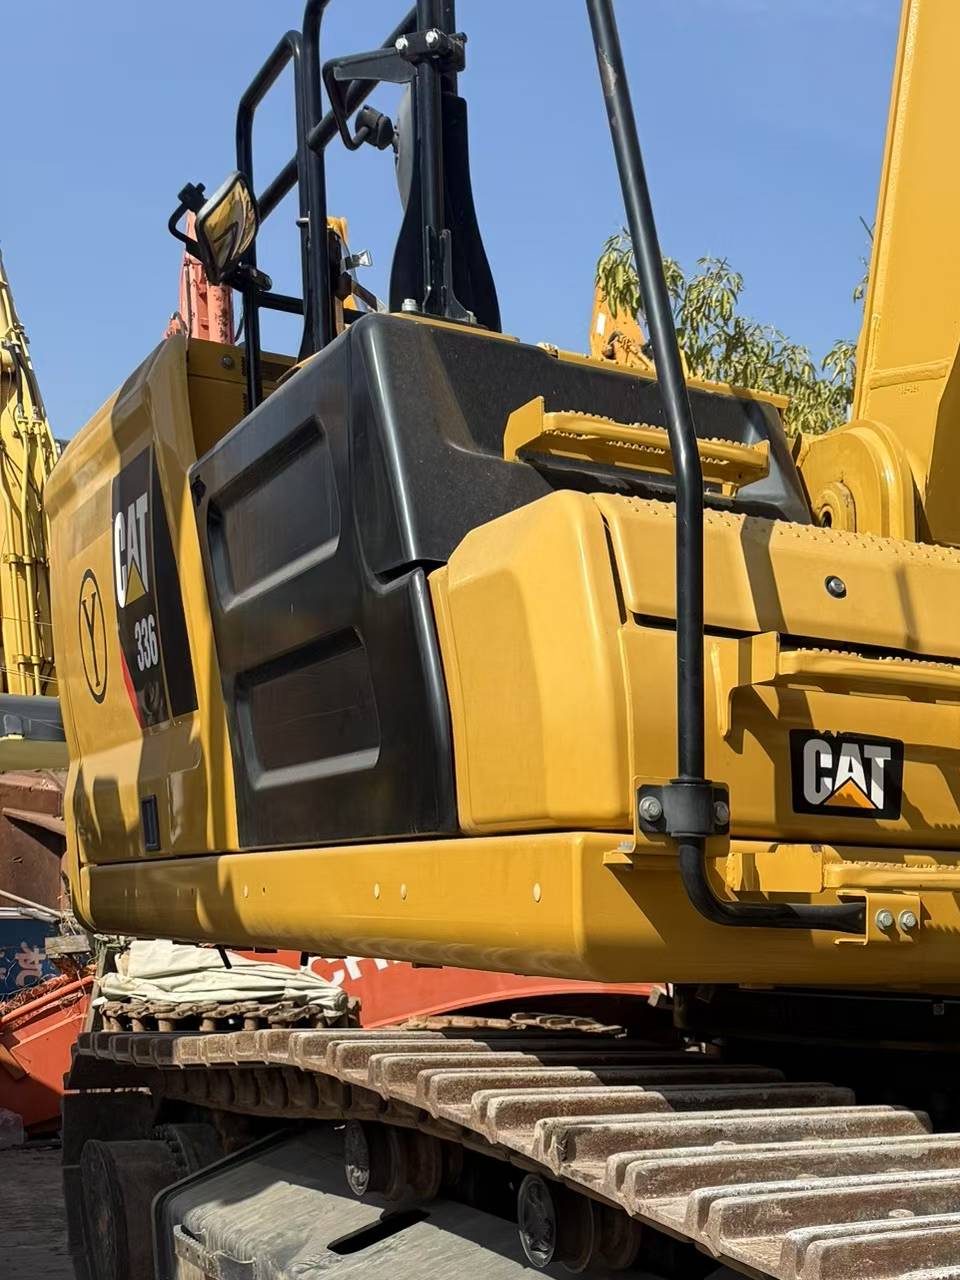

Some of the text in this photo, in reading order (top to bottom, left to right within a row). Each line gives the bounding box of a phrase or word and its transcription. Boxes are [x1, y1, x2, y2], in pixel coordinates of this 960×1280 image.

[114, 492, 149, 608] CAT
[134, 613, 159, 671] 336
[803, 738, 892, 810] CAT
